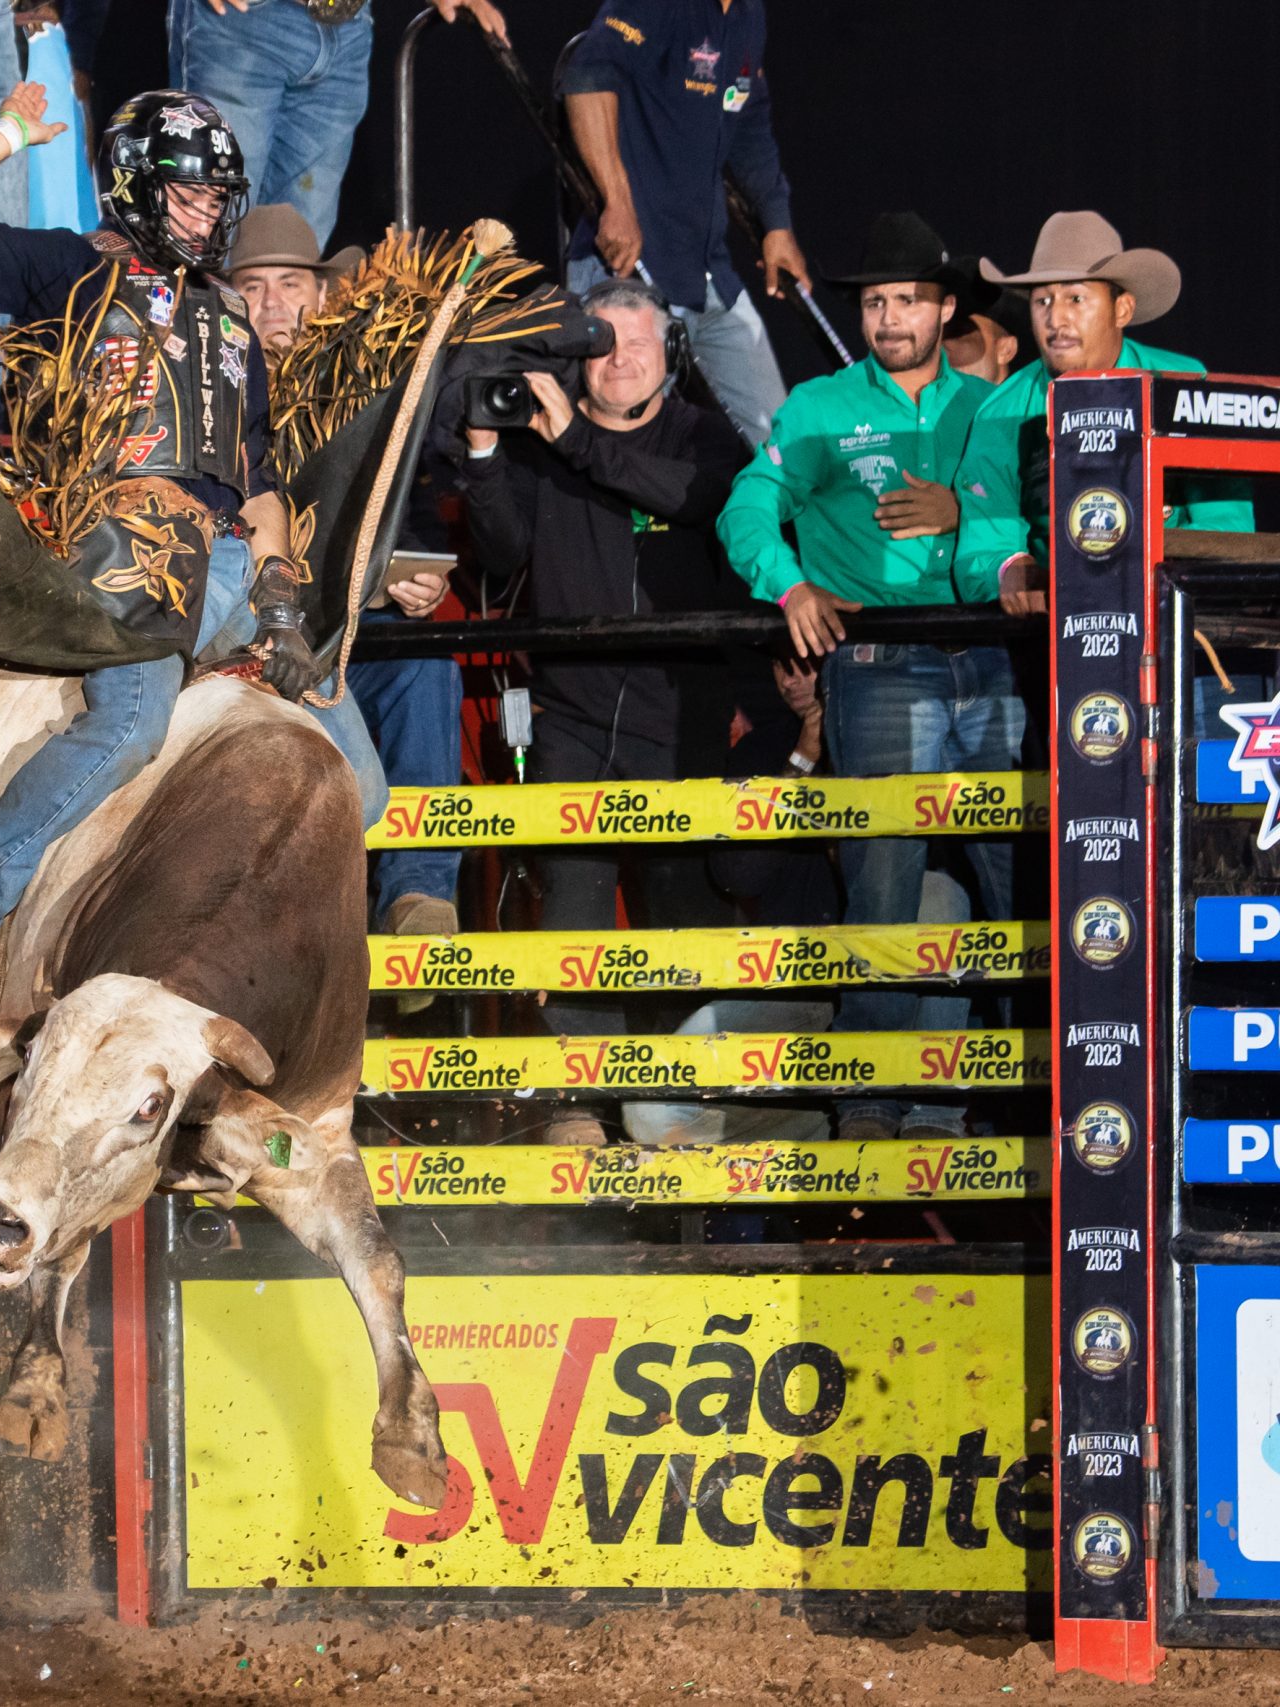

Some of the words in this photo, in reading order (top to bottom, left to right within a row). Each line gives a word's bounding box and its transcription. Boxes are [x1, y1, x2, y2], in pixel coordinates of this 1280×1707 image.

[211, 129, 232, 154] 90
[1061, 408, 1135, 434] AMERICANA
[1173, 390, 1280, 429] AMERIC
[1079, 429, 1116, 453] 2023
[1063, 612, 1138, 638] AMERICANA
[1082, 633, 1119, 657] 2023
[429, 793, 473, 817] são
[603, 789, 648, 813] são
[780, 786, 825, 809] são
[914, 783, 960, 827] SV
[959, 781, 1005, 806] são
[386, 794, 430, 838] SV
[560, 790, 605, 834] SV
[736, 787, 781, 830] SV
[774, 806, 869, 831] vicente
[953, 800, 1050, 827] vicente
[423, 814, 515, 838] vicente
[598, 810, 691, 834] vicente
[1065, 818, 1140, 843] AMERICANA
[1083, 838, 1121, 862] 2023
[781, 937, 827, 961] são
[916, 928, 963, 974] SV
[961, 927, 1007, 951] são
[385, 943, 429, 987] SV
[428, 942, 472, 965] são
[603, 944, 648, 967] são
[738, 938, 783, 983] SV
[422, 962, 515, 987] vicente
[560, 944, 605, 989] SV
[597, 963, 693, 989] vicente
[786, 1037, 831, 1060] são
[965, 1035, 1011, 1059] são
[1066, 1024, 1140, 1048] AMERICANA
[433, 1045, 478, 1068] são
[565, 1041, 610, 1084] SV
[607, 1040, 654, 1064] são
[742, 1038, 787, 1082] SV
[921, 1036, 966, 1080] SV
[1085, 1043, 1122, 1066] 2023
[390, 1046, 435, 1091] SV
[427, 1065, 521, 1088] vicente
[602, 1060, 696, 1084] vicente
[779, 1057, 875, 1081] vicente
[420, 1151, 464, 1174] são
[771, 1148, 817, 1172] são
[950, 1145, 997, 1169] são
[1228, 1125, 1280, 1175] P
[376, 1152, 422, 1195] SV
[906, 1146, 953, 1192] SV
[945, 1165, 1040, 1191] vicente
[414, 1172, 506, 1195] vicente
[588, 1172, 682, 1195] vicente
[1067, 1228, 1141, 1253] AMERICANA
[1085, 1248, 1122, 1271] 2023
[410, 1324, 560, 1349] PERMERCADOS
[605, 1314, 847, 1437] são
[1067, 1433, 1141, 1456] AMERICANA
[1085, 1453, 1122, 1476] 2023
[578, 1428, 1054, 1549] vicente
